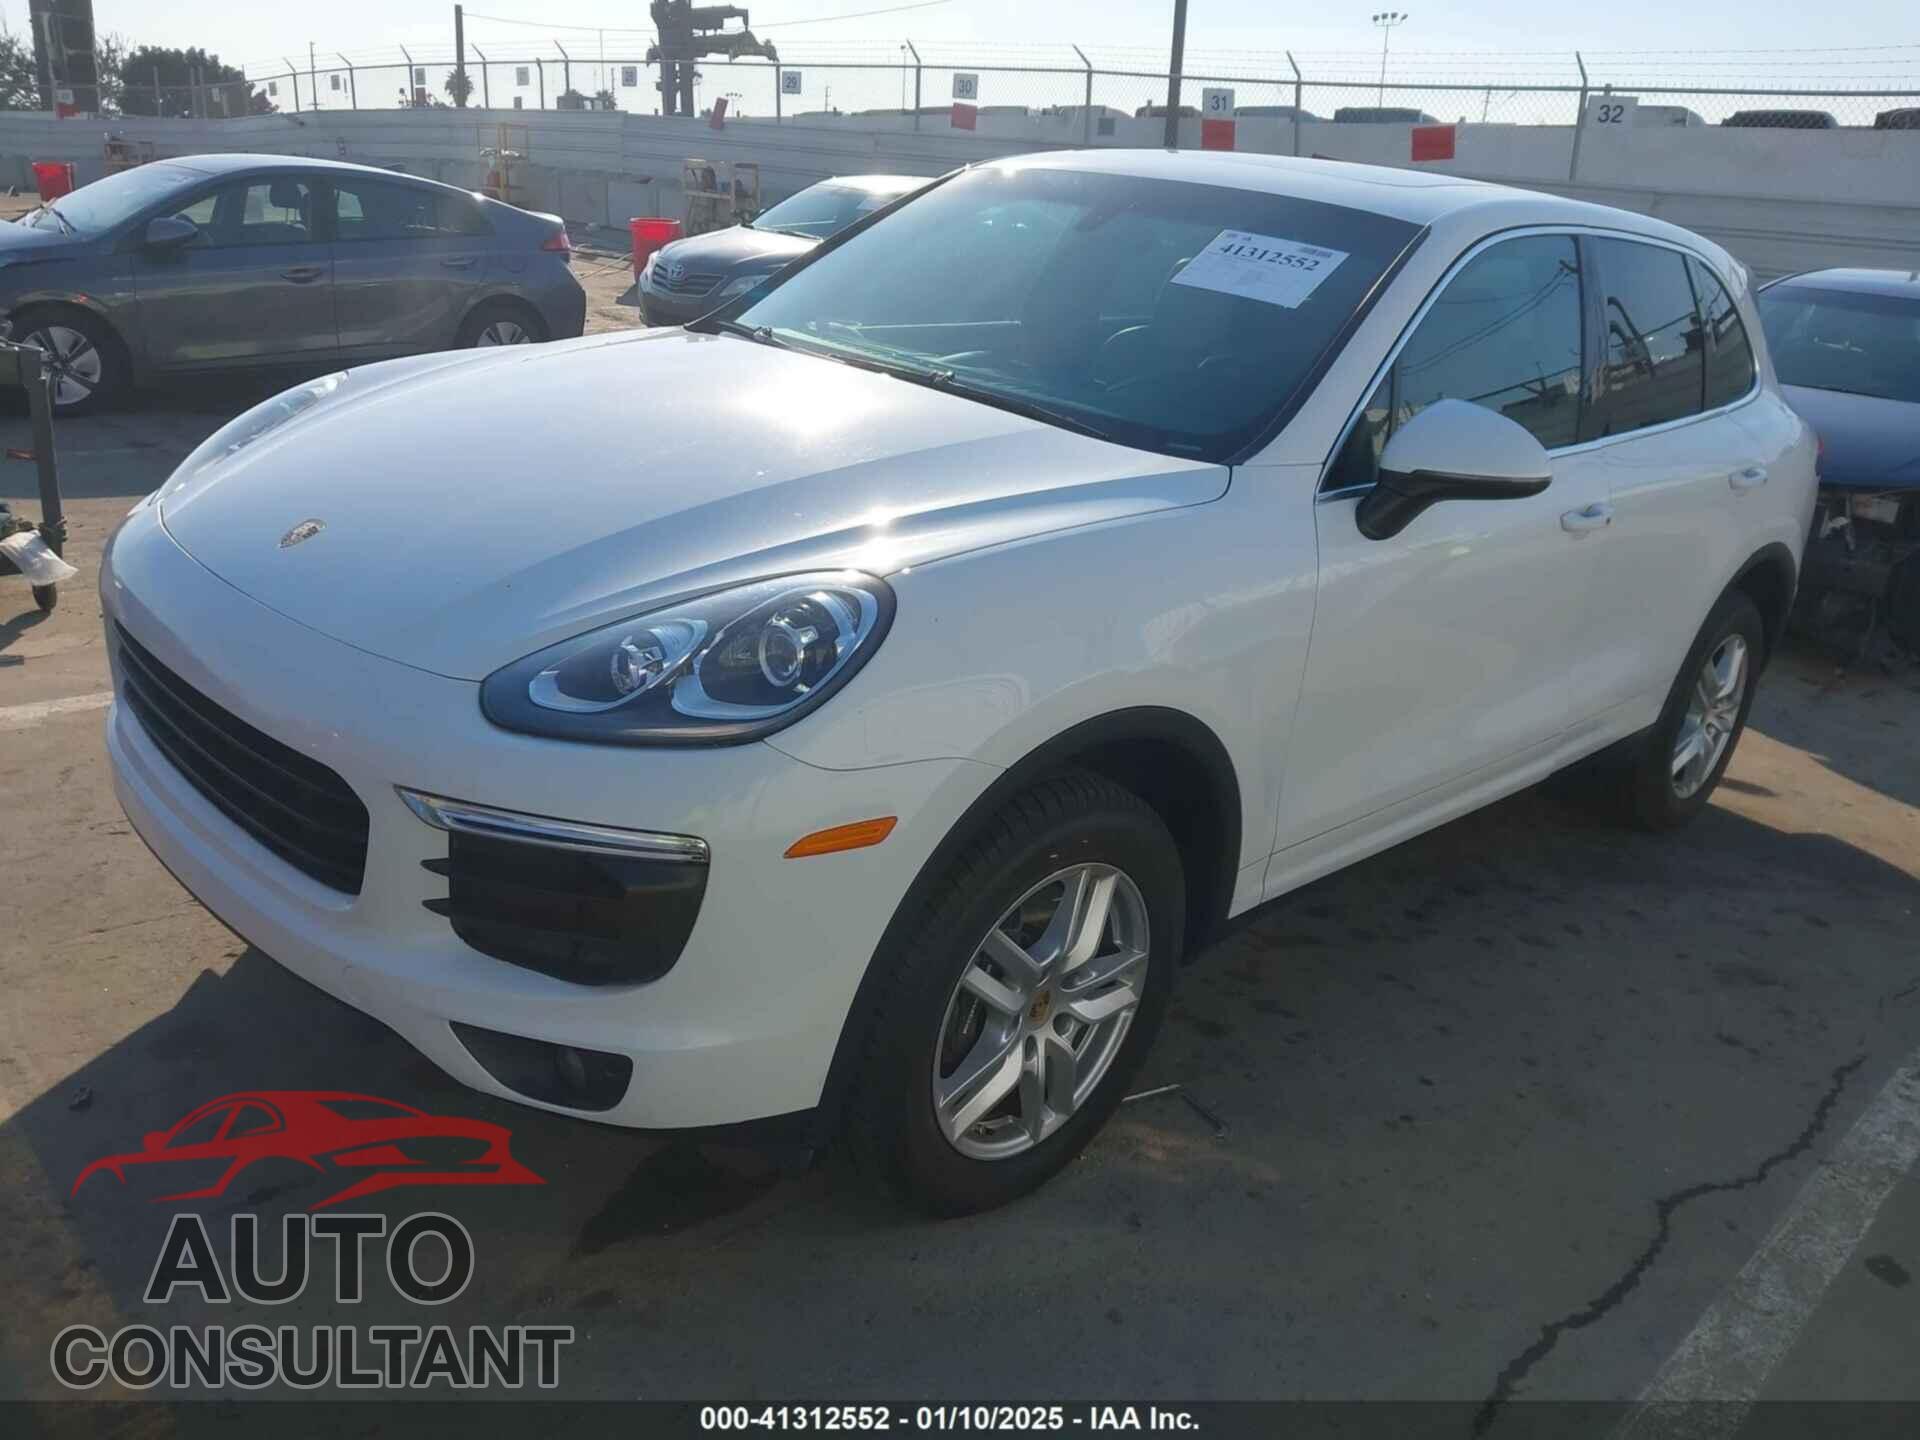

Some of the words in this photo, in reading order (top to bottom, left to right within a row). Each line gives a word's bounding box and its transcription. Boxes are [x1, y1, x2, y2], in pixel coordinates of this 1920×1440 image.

[1211, 95, 1227, 111] 31
[1598, 104, 1624, 123] 32
[1220, 243, 1320, 272] 41312552
